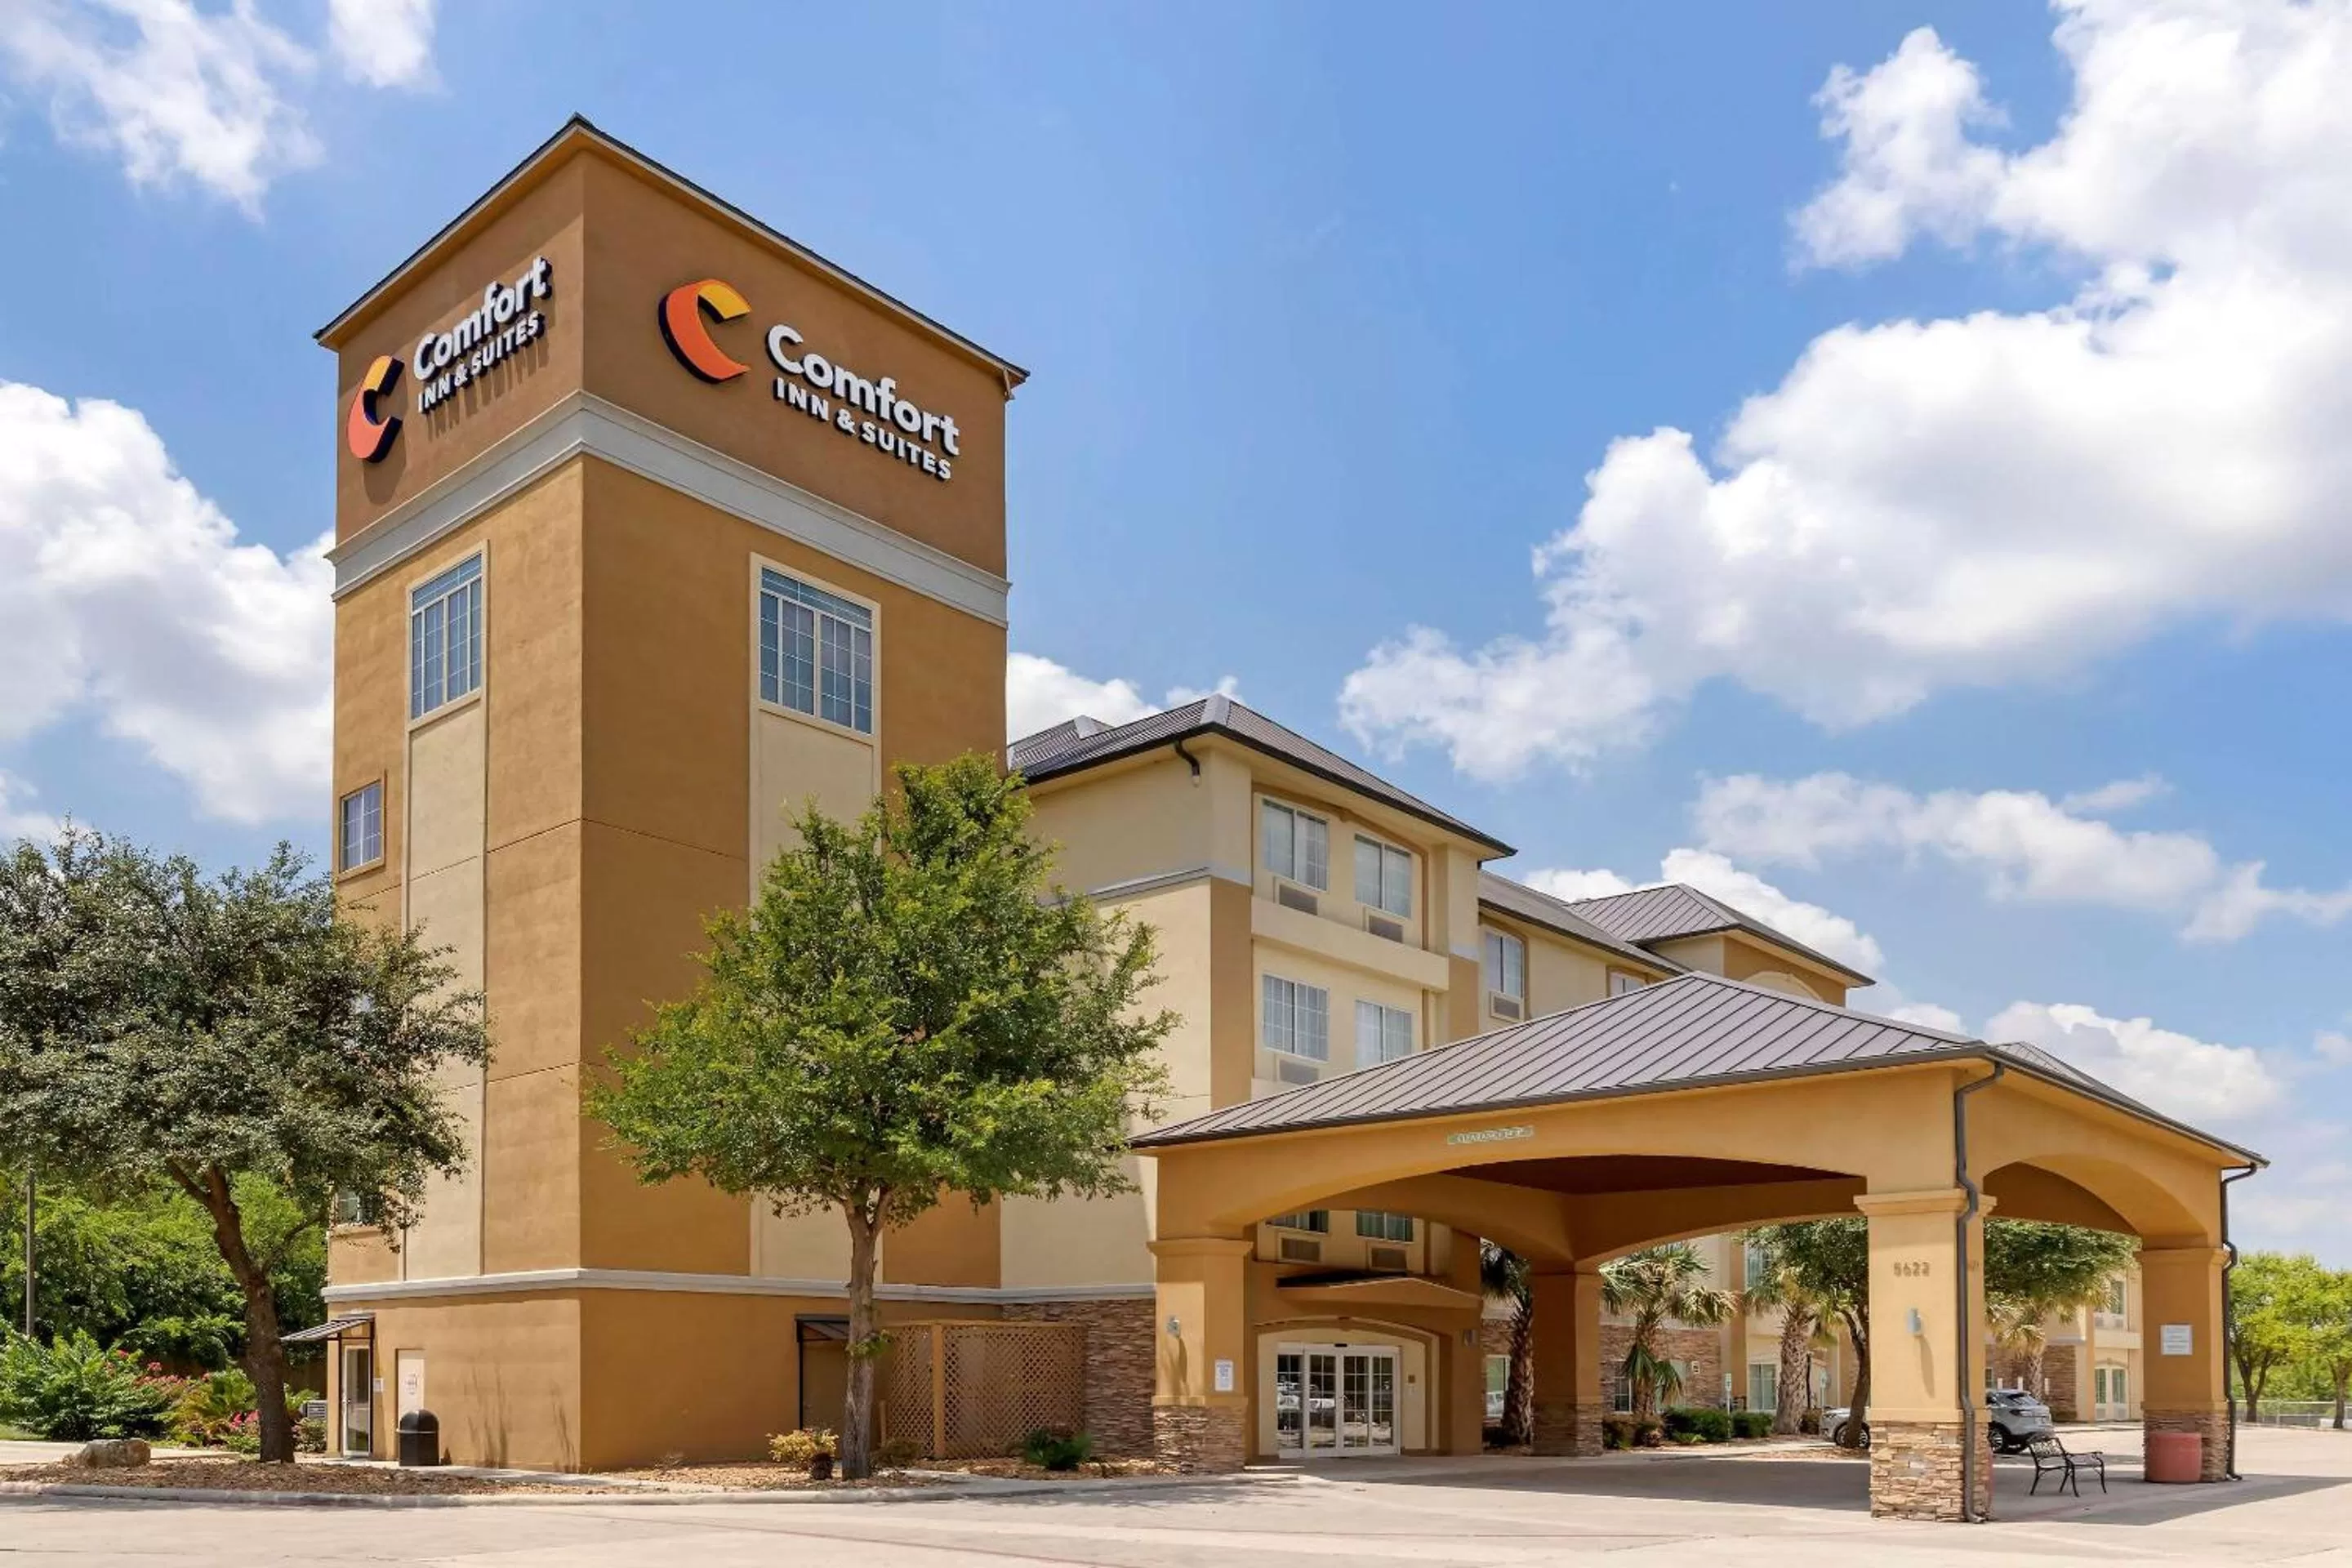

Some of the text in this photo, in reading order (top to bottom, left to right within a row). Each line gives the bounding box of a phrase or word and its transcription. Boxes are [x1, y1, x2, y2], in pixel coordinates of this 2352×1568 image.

[413, 256, 550, 381] Comfort
[418, 310, 545, 413] INN & SUITES
[766, 324, 960, 457] Comfort
[776, 369, 952, 480] INN & SUITES
